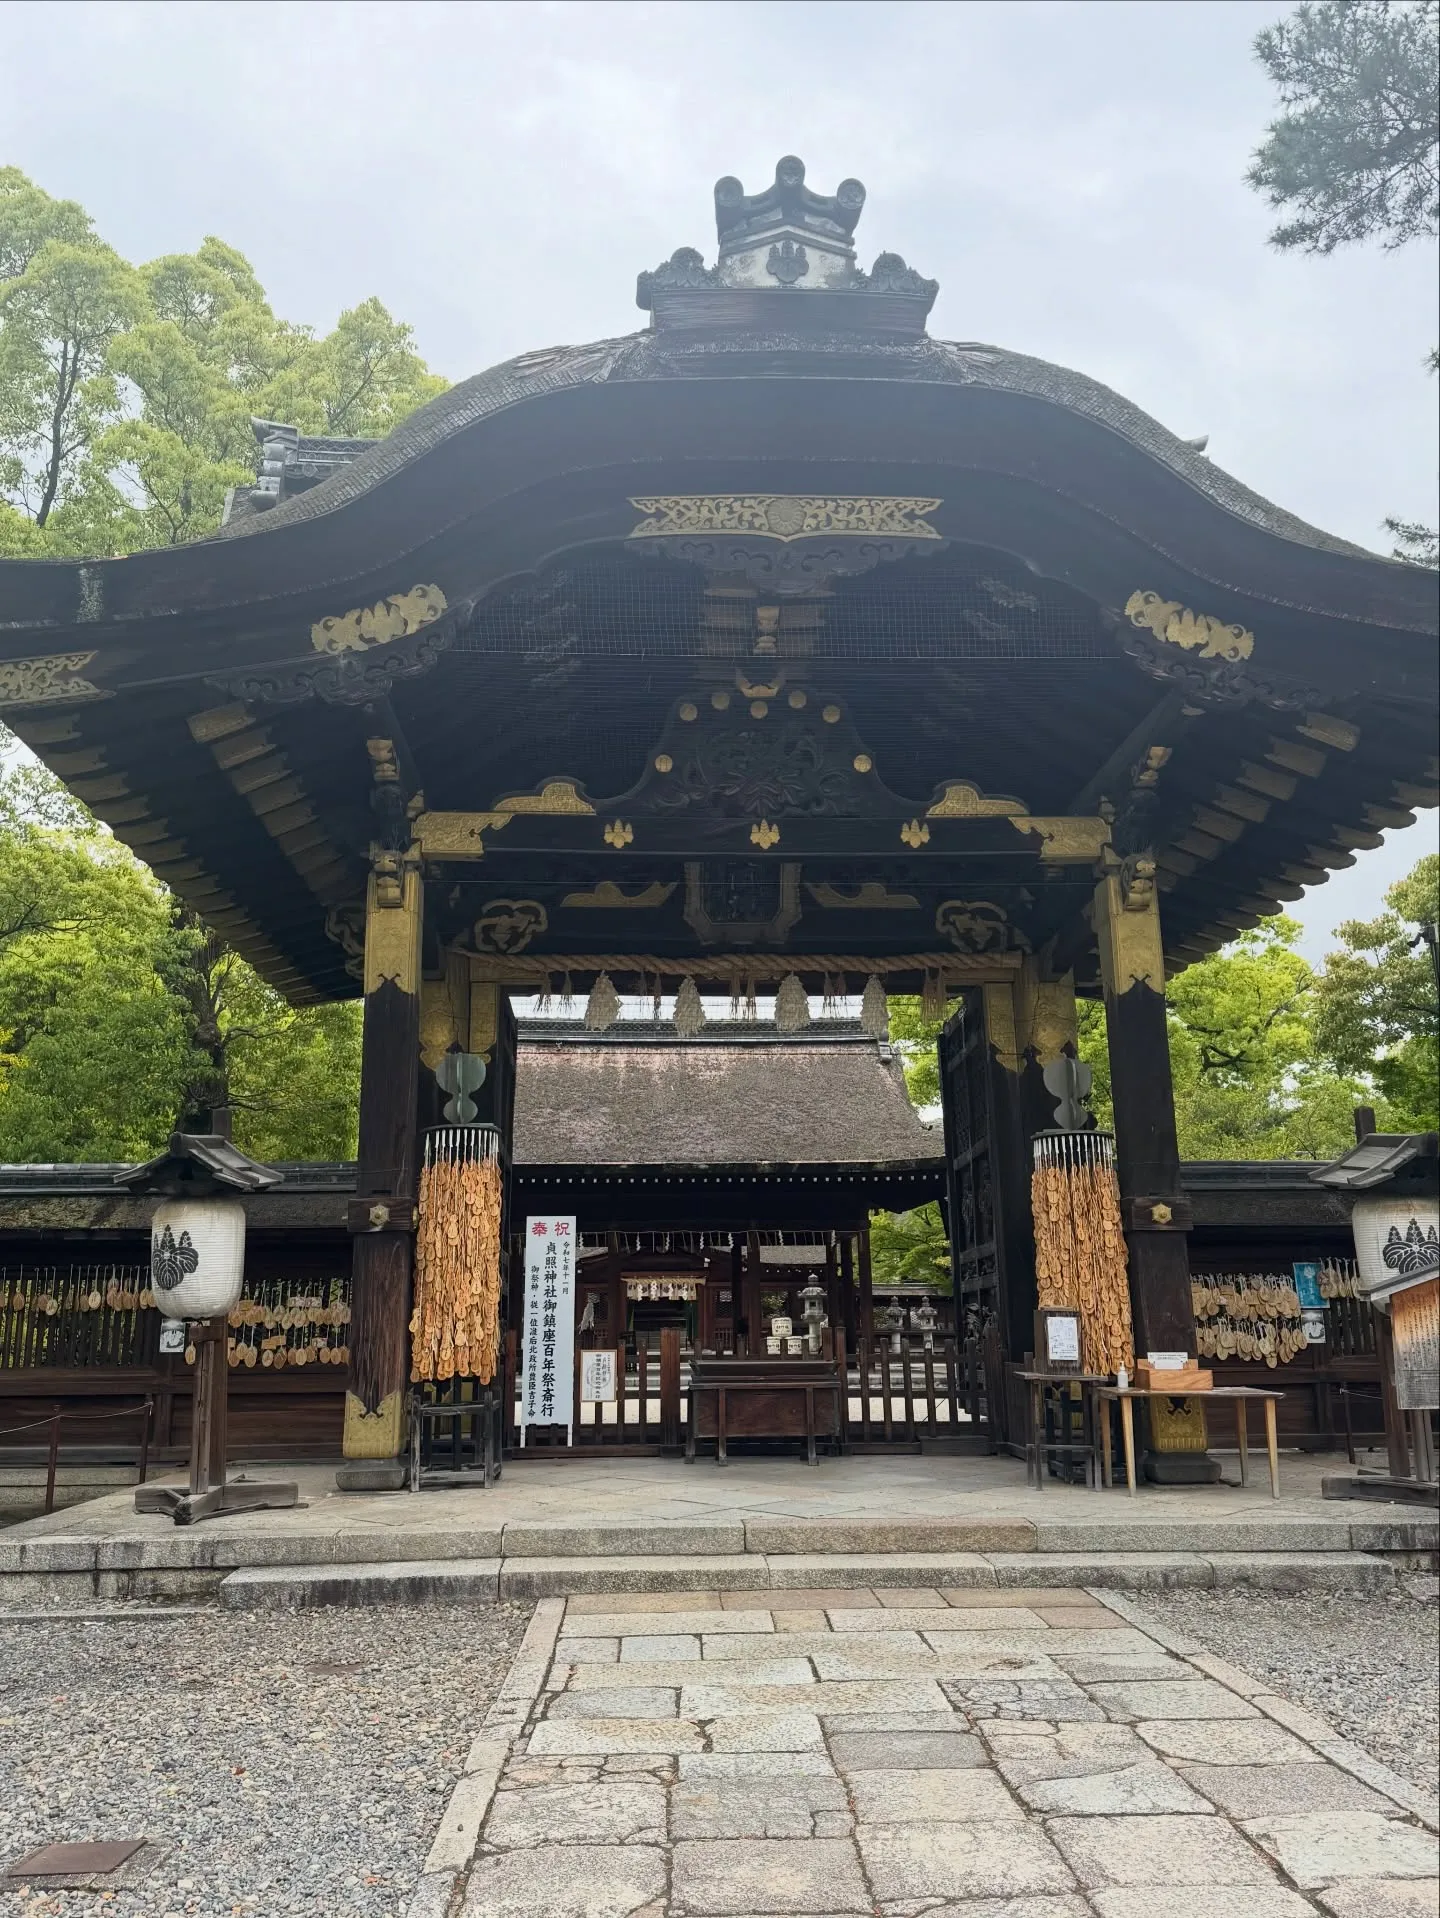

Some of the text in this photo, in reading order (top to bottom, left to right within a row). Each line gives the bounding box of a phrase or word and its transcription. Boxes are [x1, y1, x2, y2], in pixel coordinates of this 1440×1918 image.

[531, 1221, 570, 1237] 奉祝
[562, 1241, 570, 1295] 令和七年十一月
